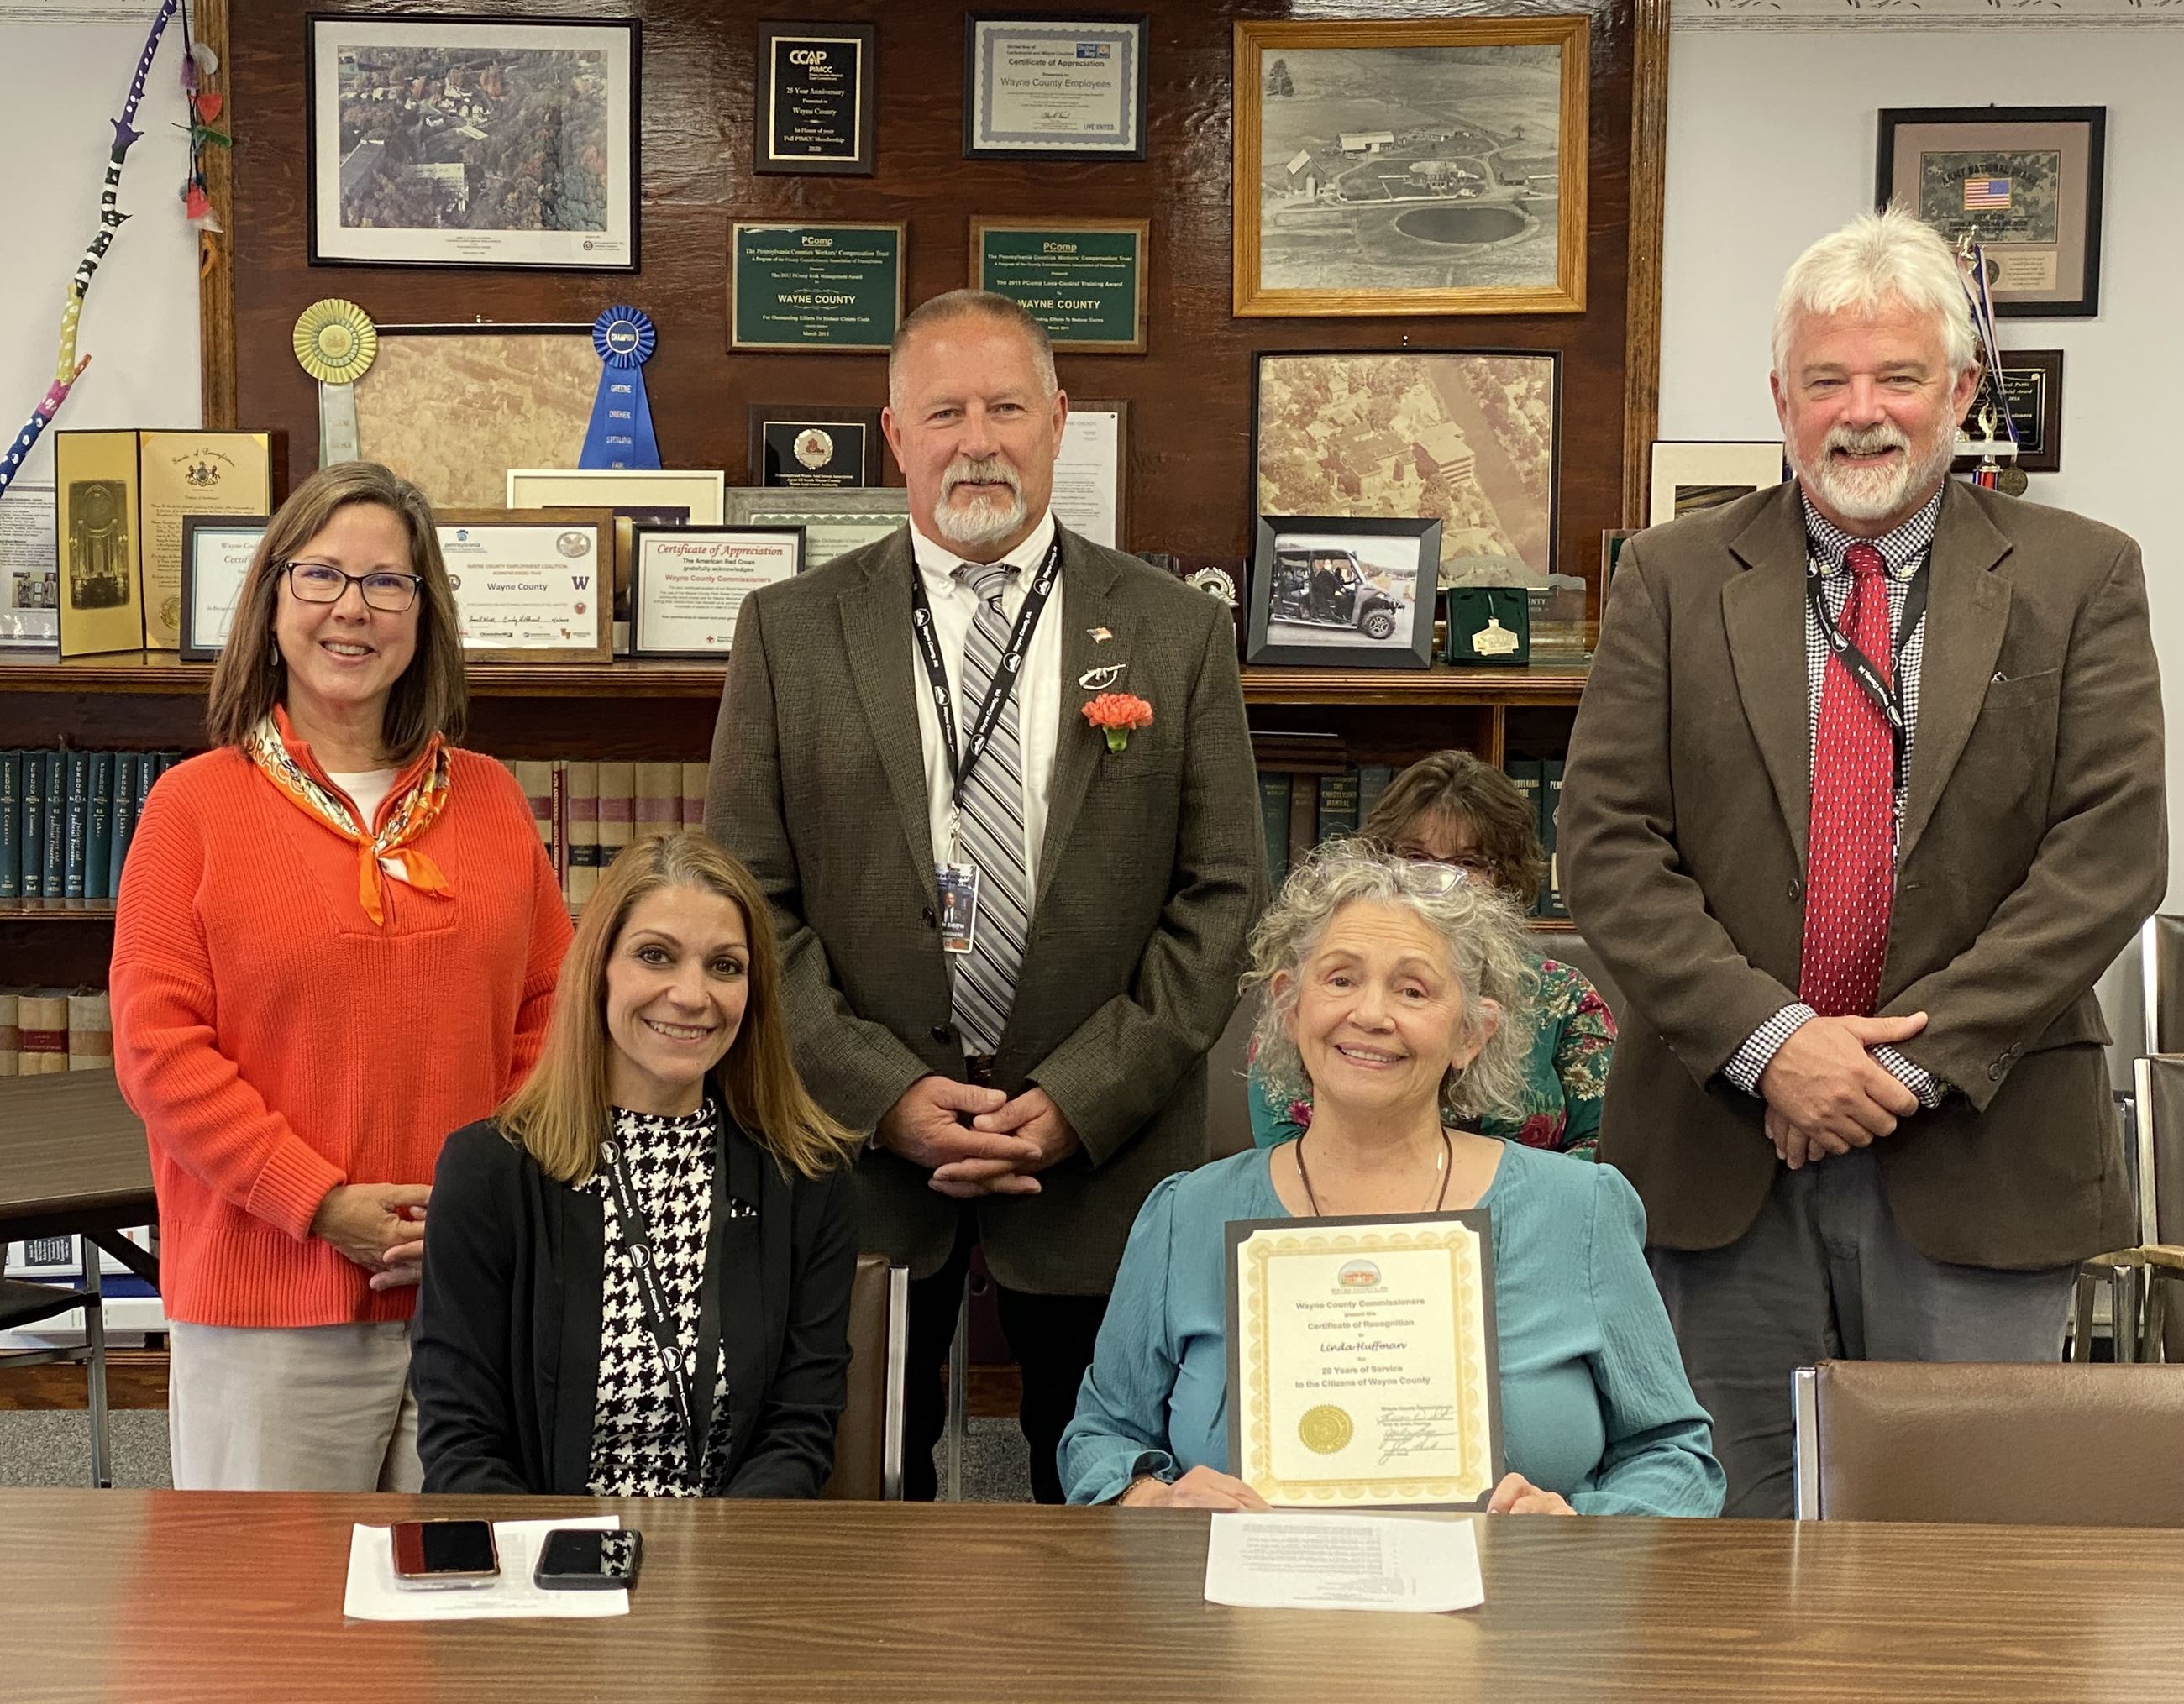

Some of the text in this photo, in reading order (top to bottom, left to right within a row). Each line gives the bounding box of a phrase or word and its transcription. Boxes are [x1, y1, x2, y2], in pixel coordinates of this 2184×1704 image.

[790, 50, 827, 65] CCAP
[1008, 58, 1105, 68] Certificate of Appreciation
[1000, 77, 1111, 89] Wayne County Employees
[810, 88, 845, 97] Anniversary
[814, 107, 837, 116] County
[801, 236, 833, 246] PComp
[756, 248, 790, 256] Pennsylvania
[1043, 242, 1077, 252] PComp
[778, 295, 856, 304] WAYNE COUNTY
[1017, 300, 1100, 309] WAYNE COUNTY
[657, 544, 783, 558] Certificate of Appreciation
[487, 582, 548, 592] Wayne County
[571, 575, 590, 590] W
[1013, 637, 1023, 653] Wayne
[1026, 611, 1032, 620] PA
[979, 717, 990, 733] Wayne
[995, 688, 1002, 698] PA
[613, 1163, 623, 1186] Wayne
[626, 1208, 634, 1218] PA
[643, 1266, 654, 1289] Wayne
[656, 1312, 664, 1324] PA
[1296, 1298, 1425, 1310] Wayne County Commissioners
[1308, 1319, 1415, 1330] Certificate of Recognition
[1320, 1340, 1408, 1352] Linda Huffman
[1334, 1366, 1358, 1375] Years
[1371, 1365, 1403, 1373] Service
[1368, 1377, 1398, 1387] Wayne
[1399, 1376, 1431, 1386] County
